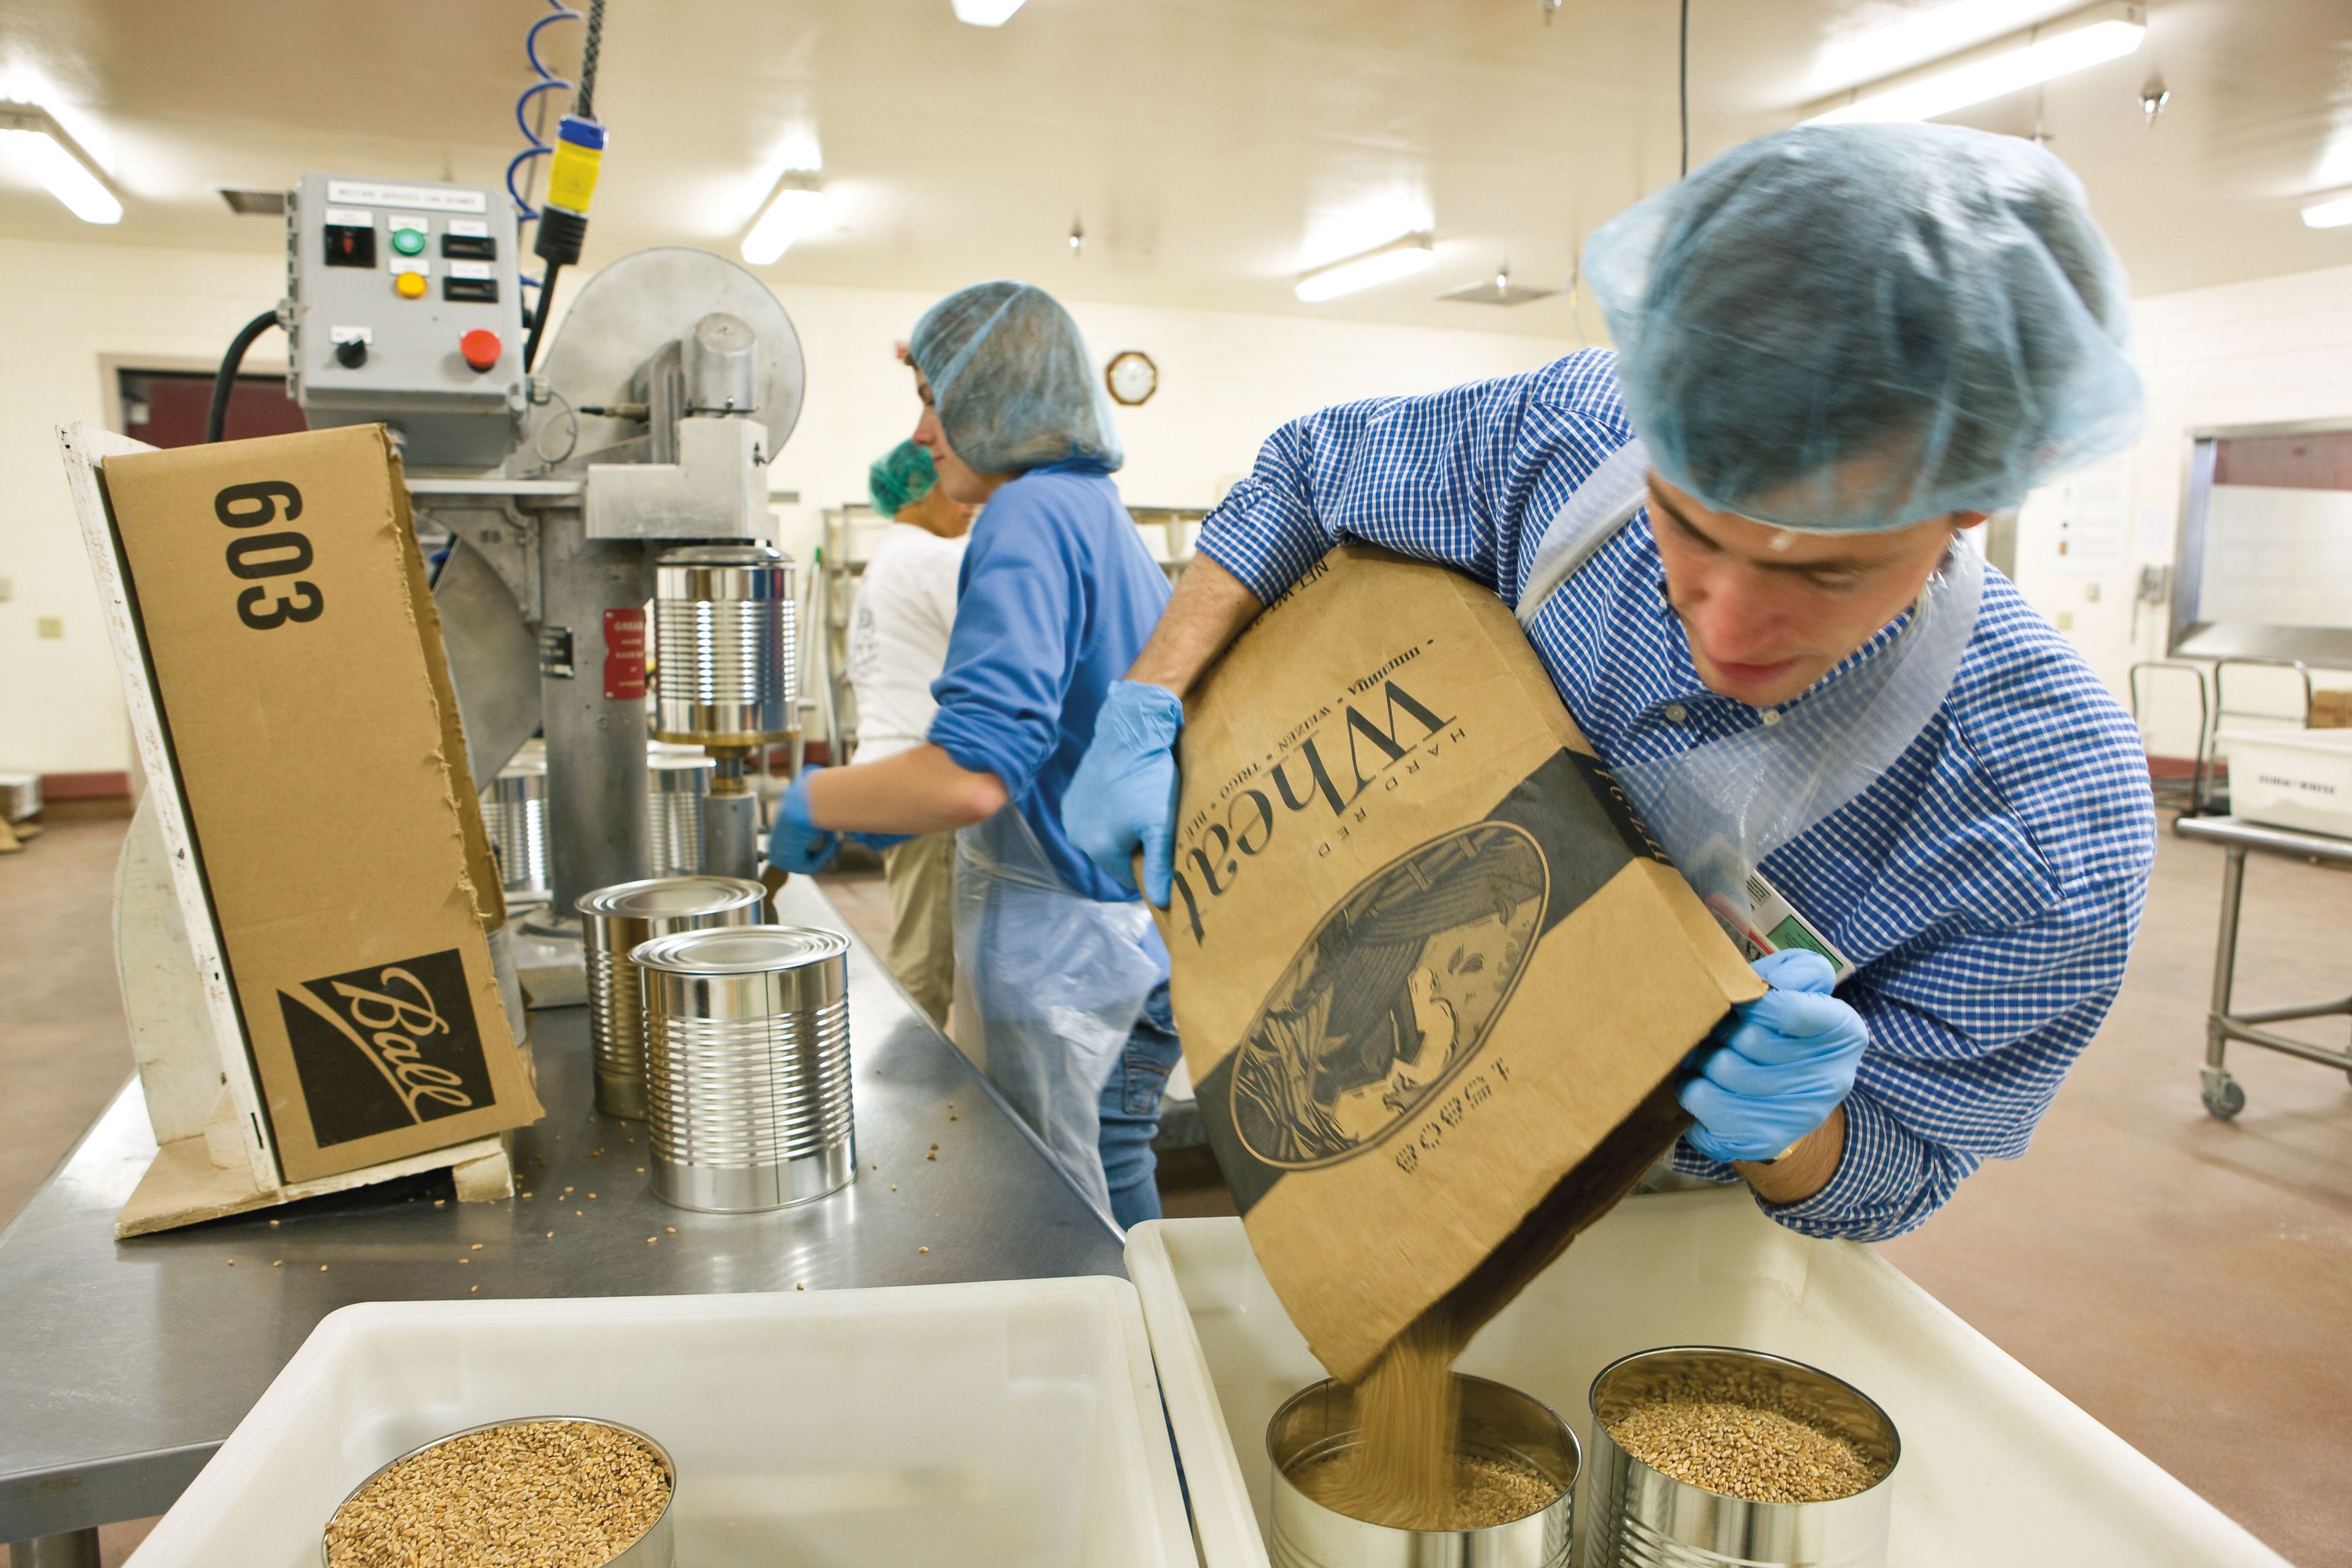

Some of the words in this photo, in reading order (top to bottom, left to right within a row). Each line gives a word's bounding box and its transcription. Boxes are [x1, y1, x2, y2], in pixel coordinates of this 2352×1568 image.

[215, 481, 323, 630] 603
[1348, 646, 1421, 695] ПШЕНИЦА
[1278, 706, 1331, 752] WEIZEN
[1385, 728, 1465, 791] HARD
[1219, 764, 1262, 799] TRIGO
[1172, 679, 1458, 948] Wheat
[1319, 808, 1368, 858] RED
[331, 967, 472, 1123] Ball
[1396, 1057, 1509, 1175] 15808
